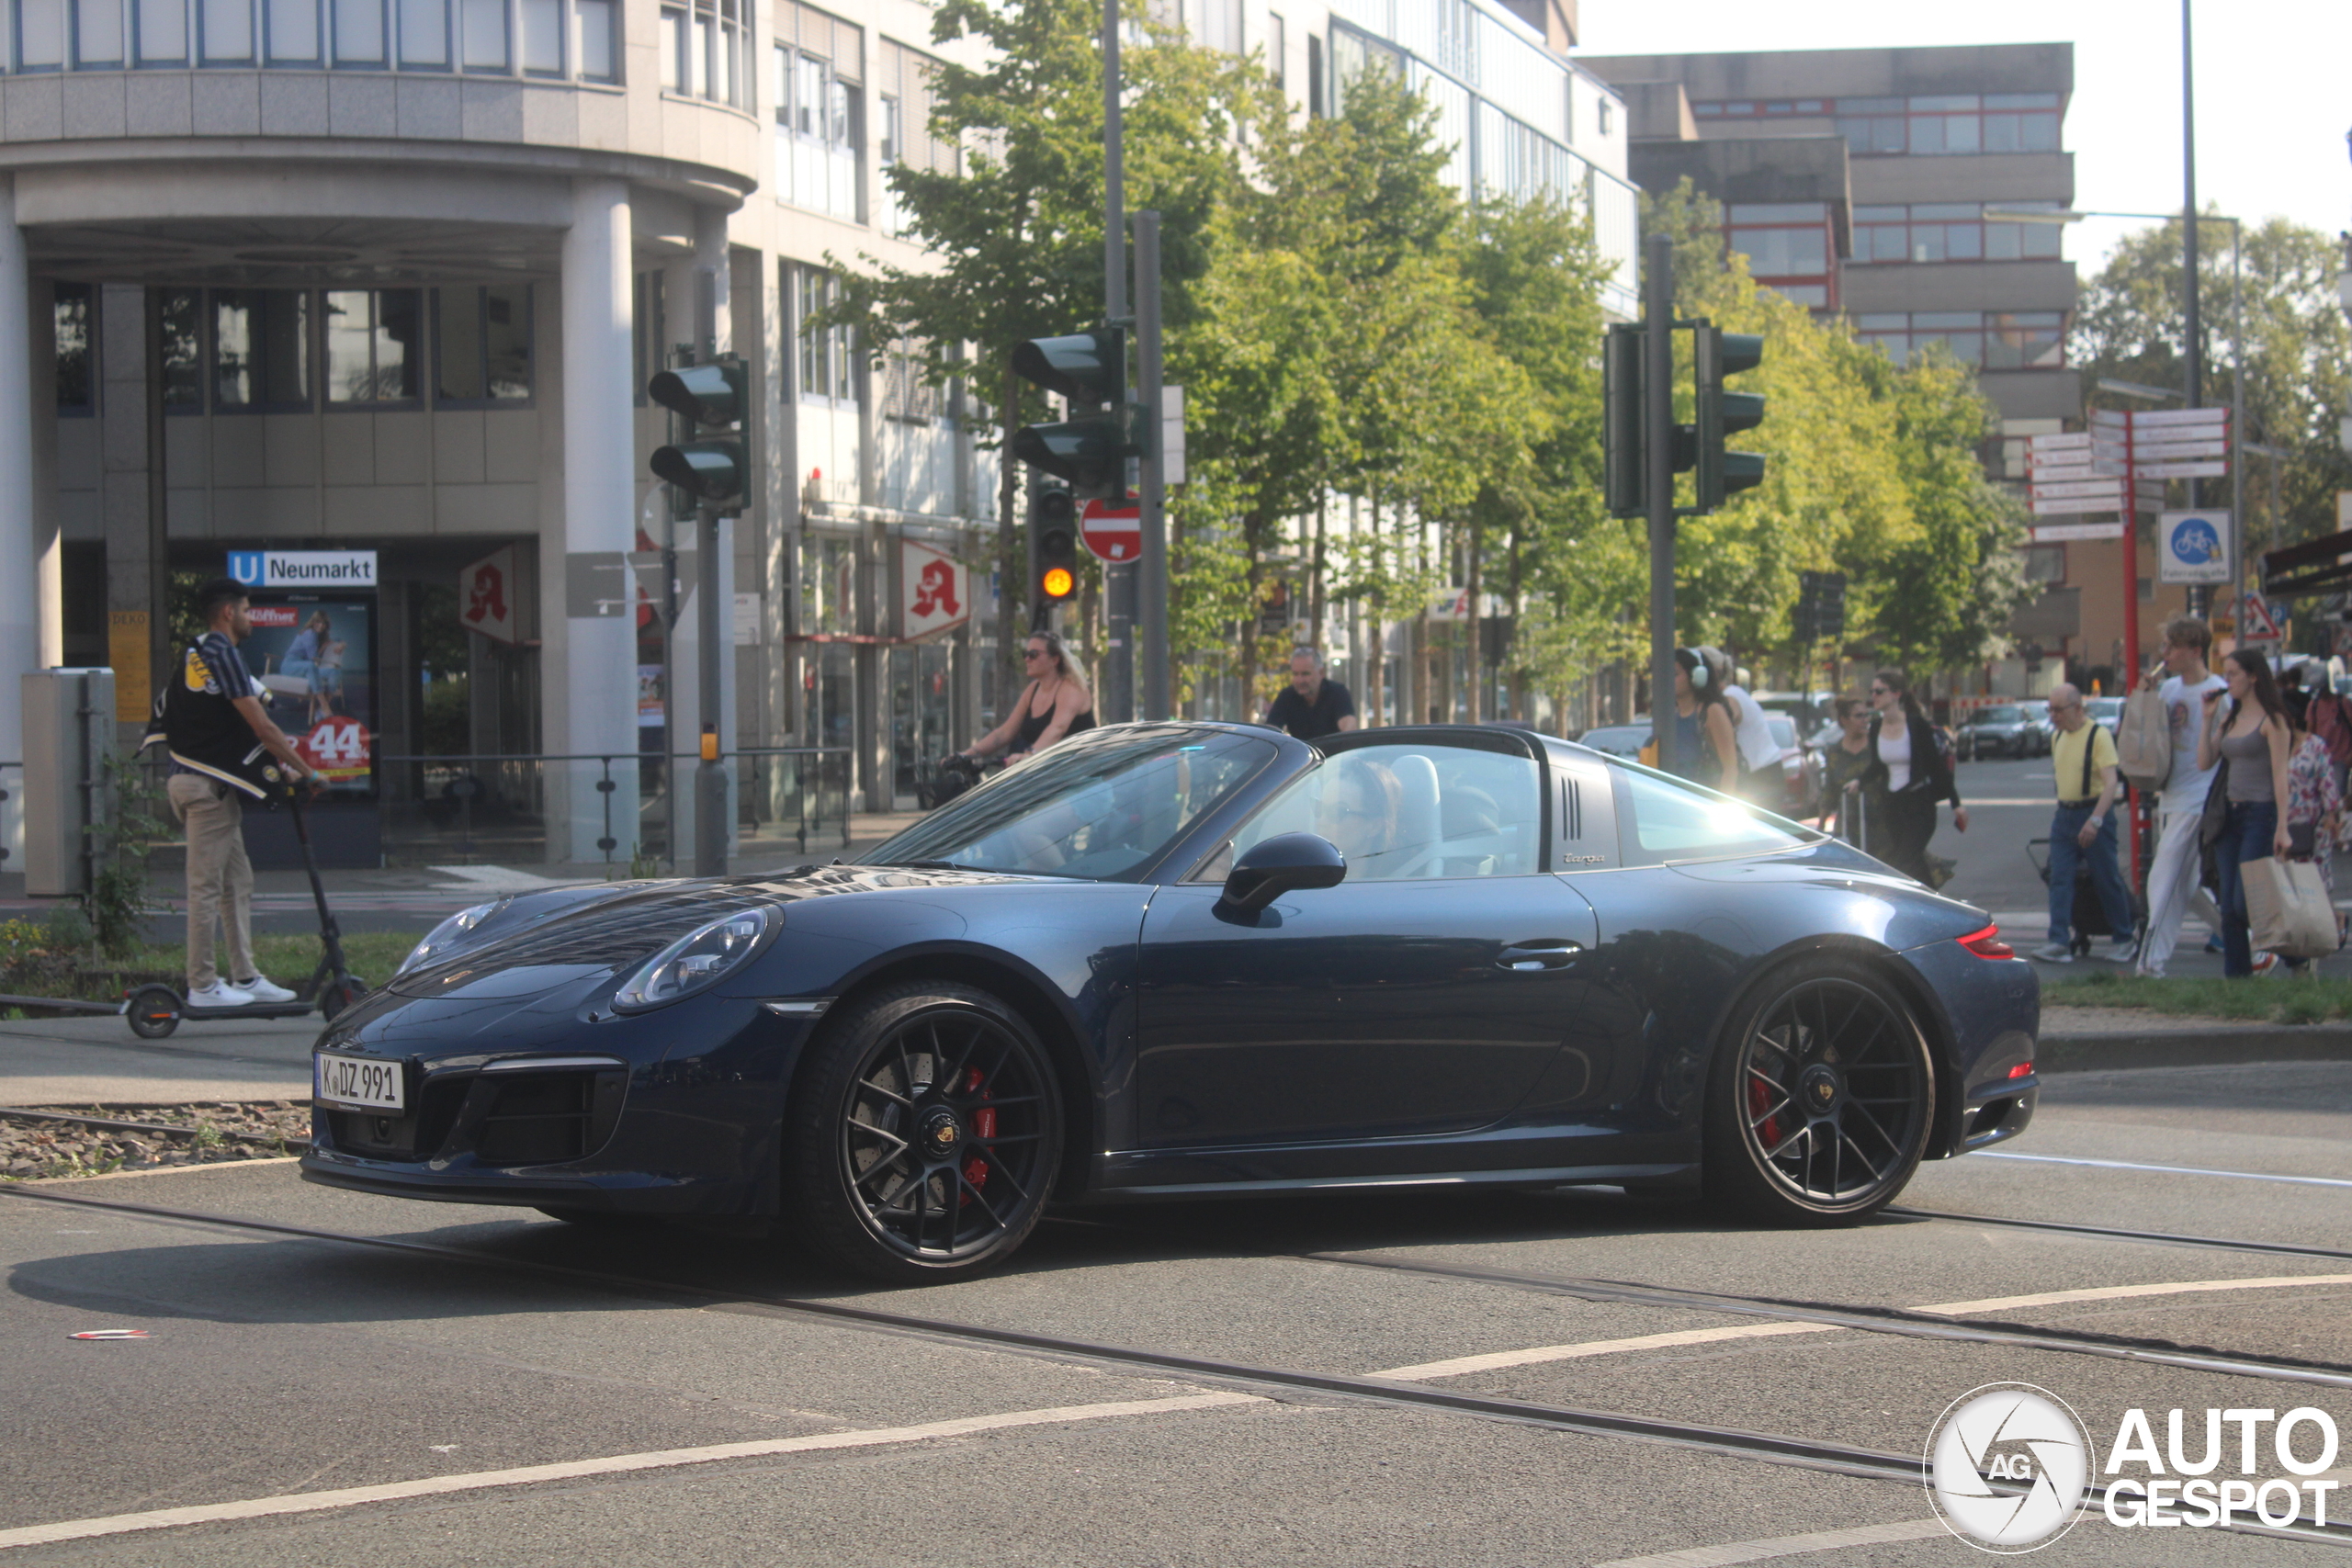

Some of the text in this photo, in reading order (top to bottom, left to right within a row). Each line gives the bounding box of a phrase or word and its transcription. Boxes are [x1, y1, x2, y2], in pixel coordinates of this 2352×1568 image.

[234, 556, 371, 583] U Neumarkt
[323, 1058, 395, 1101] K DZ 991
